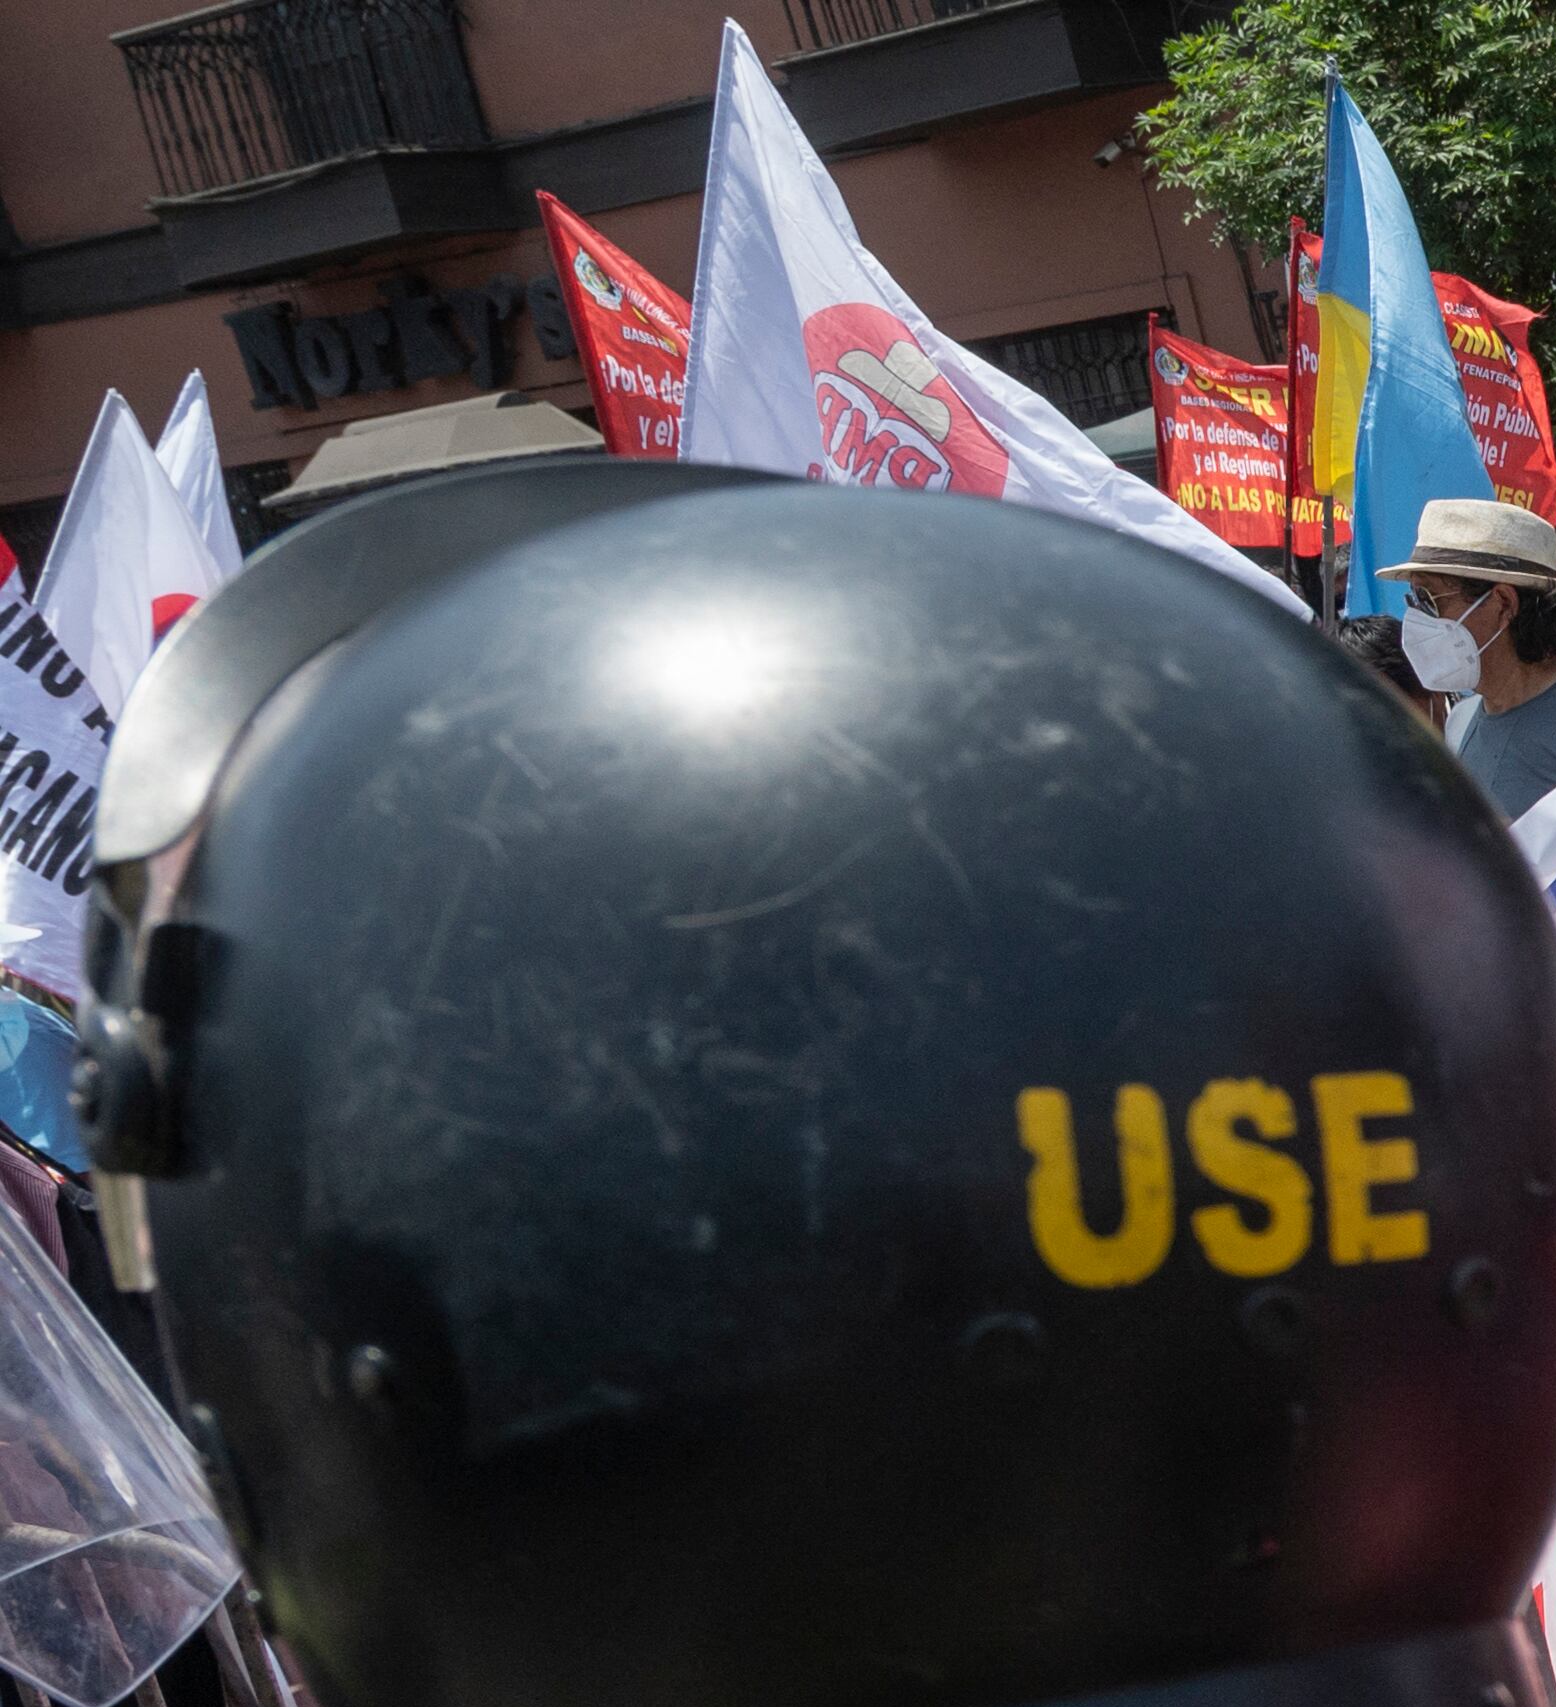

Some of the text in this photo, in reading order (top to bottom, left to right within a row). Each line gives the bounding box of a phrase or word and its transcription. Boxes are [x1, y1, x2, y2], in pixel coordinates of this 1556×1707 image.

[1443, 317, 1509, 366] IMA
[1297, 343, 1318, 376] ¡Po
[638, 363, 658, 400] la
[655, 414, 674, 447] el
[1161, 416, 1280, 451] ¡Por la defensa de
[1193, 452, 1203, 476] y
[1204, 450, 1217, 473] el
[1218, 451, 1278, 481] Regimen
[1177, 482, 1207, 511] ¡NO
[1211, 484, 1224, 512] A
[1227, 486, 1262, 513] LAS
[1015, 1069, 1430, 1290] USE
